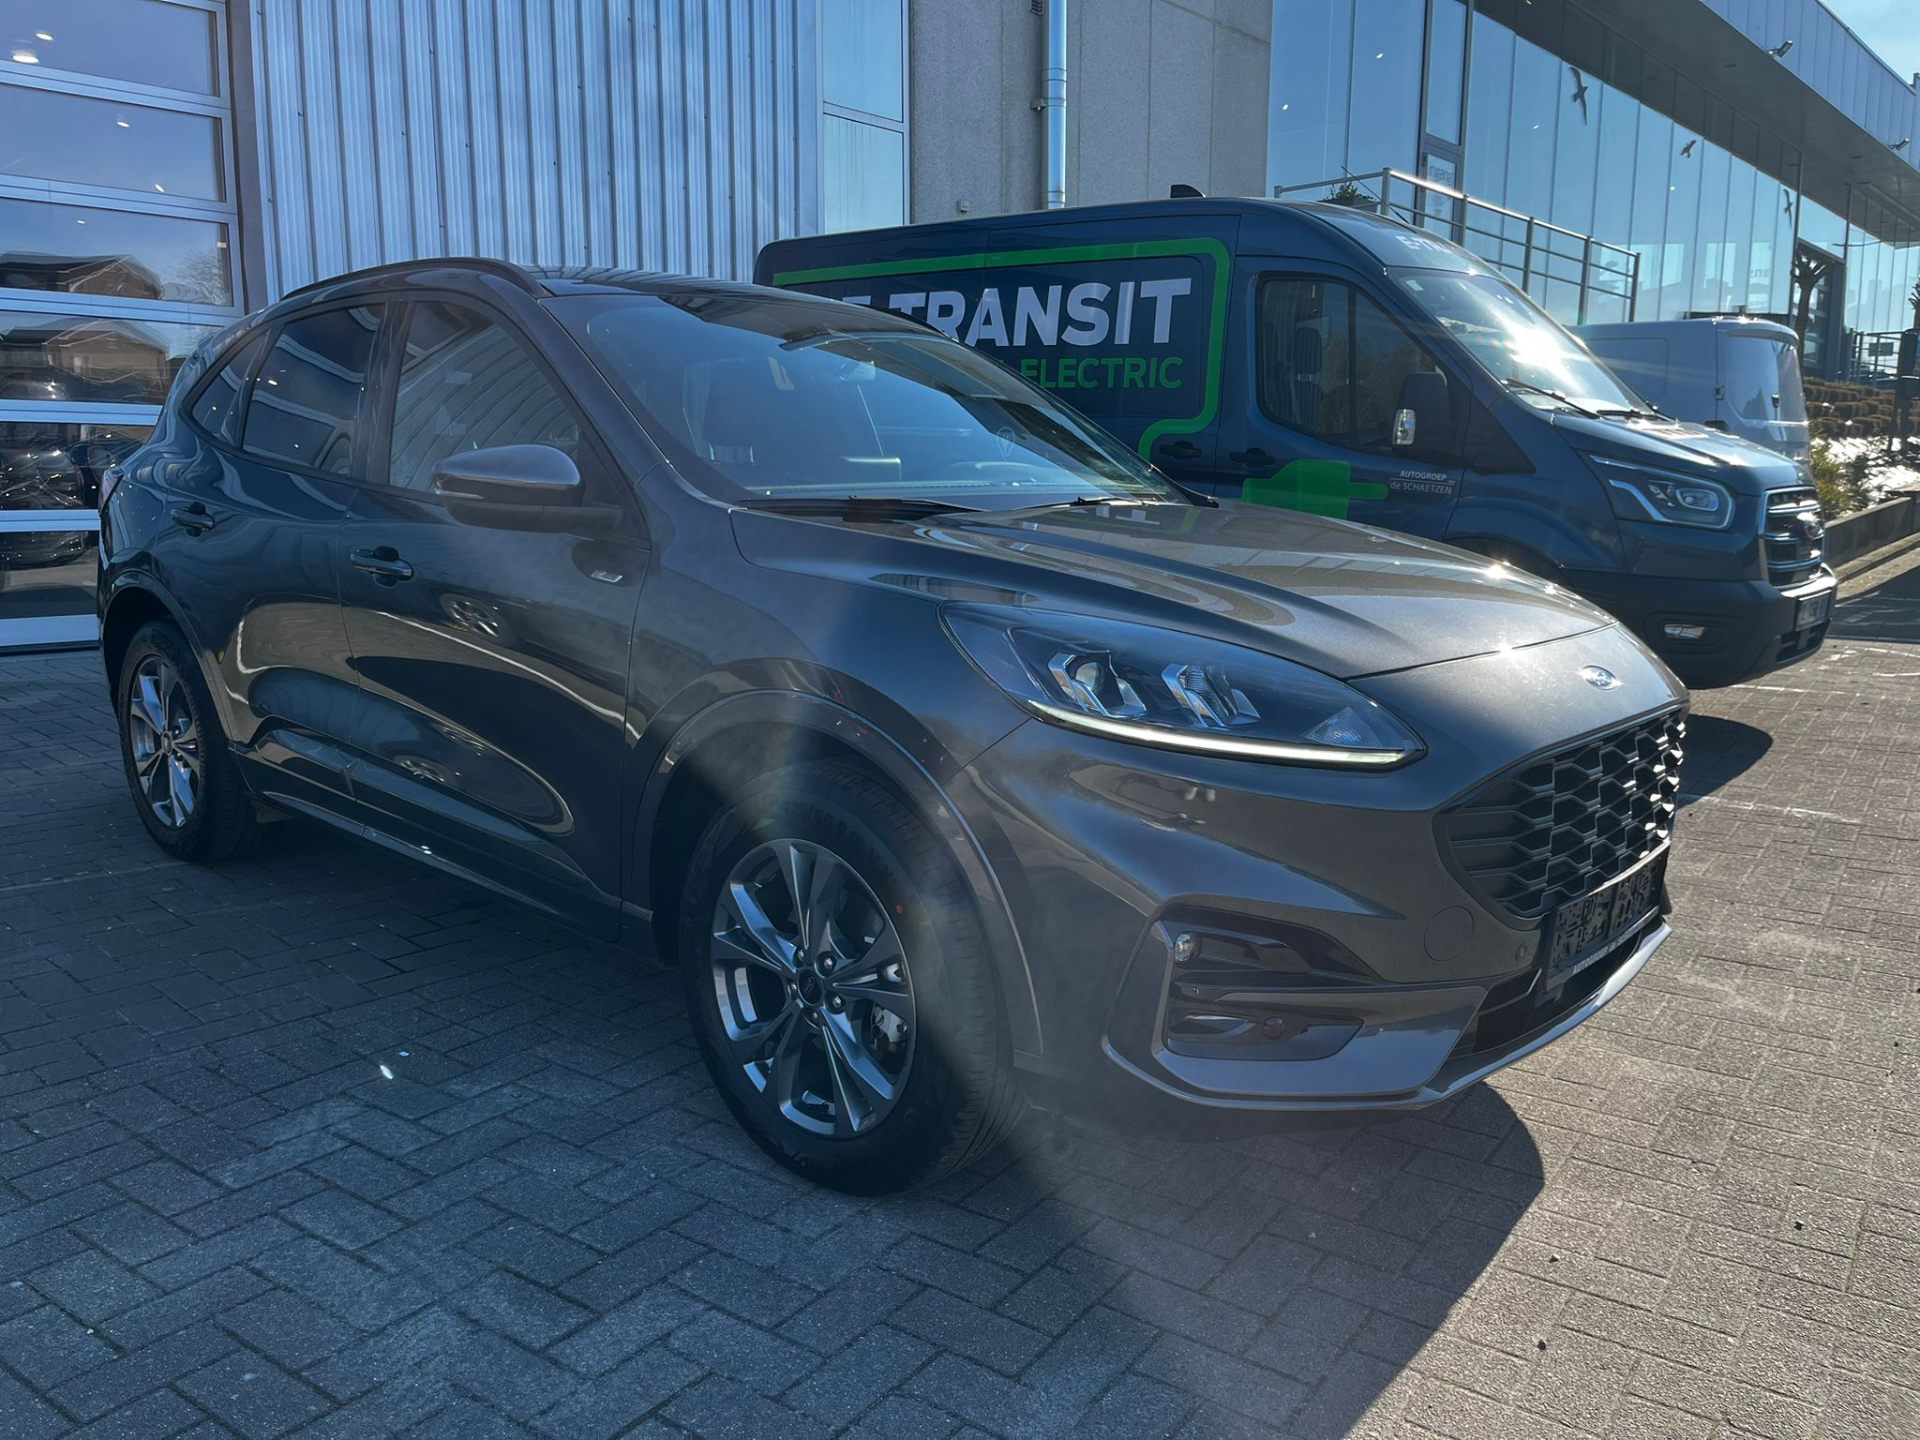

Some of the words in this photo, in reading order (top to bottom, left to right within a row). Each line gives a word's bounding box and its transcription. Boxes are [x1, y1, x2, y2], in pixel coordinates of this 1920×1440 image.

[1019, 355, 1184, 389] ELECTRIC
[1399, 470, 1448, 481] AUTOGROEP
[1402, 482, 1453, 495] SCHAETZEN
